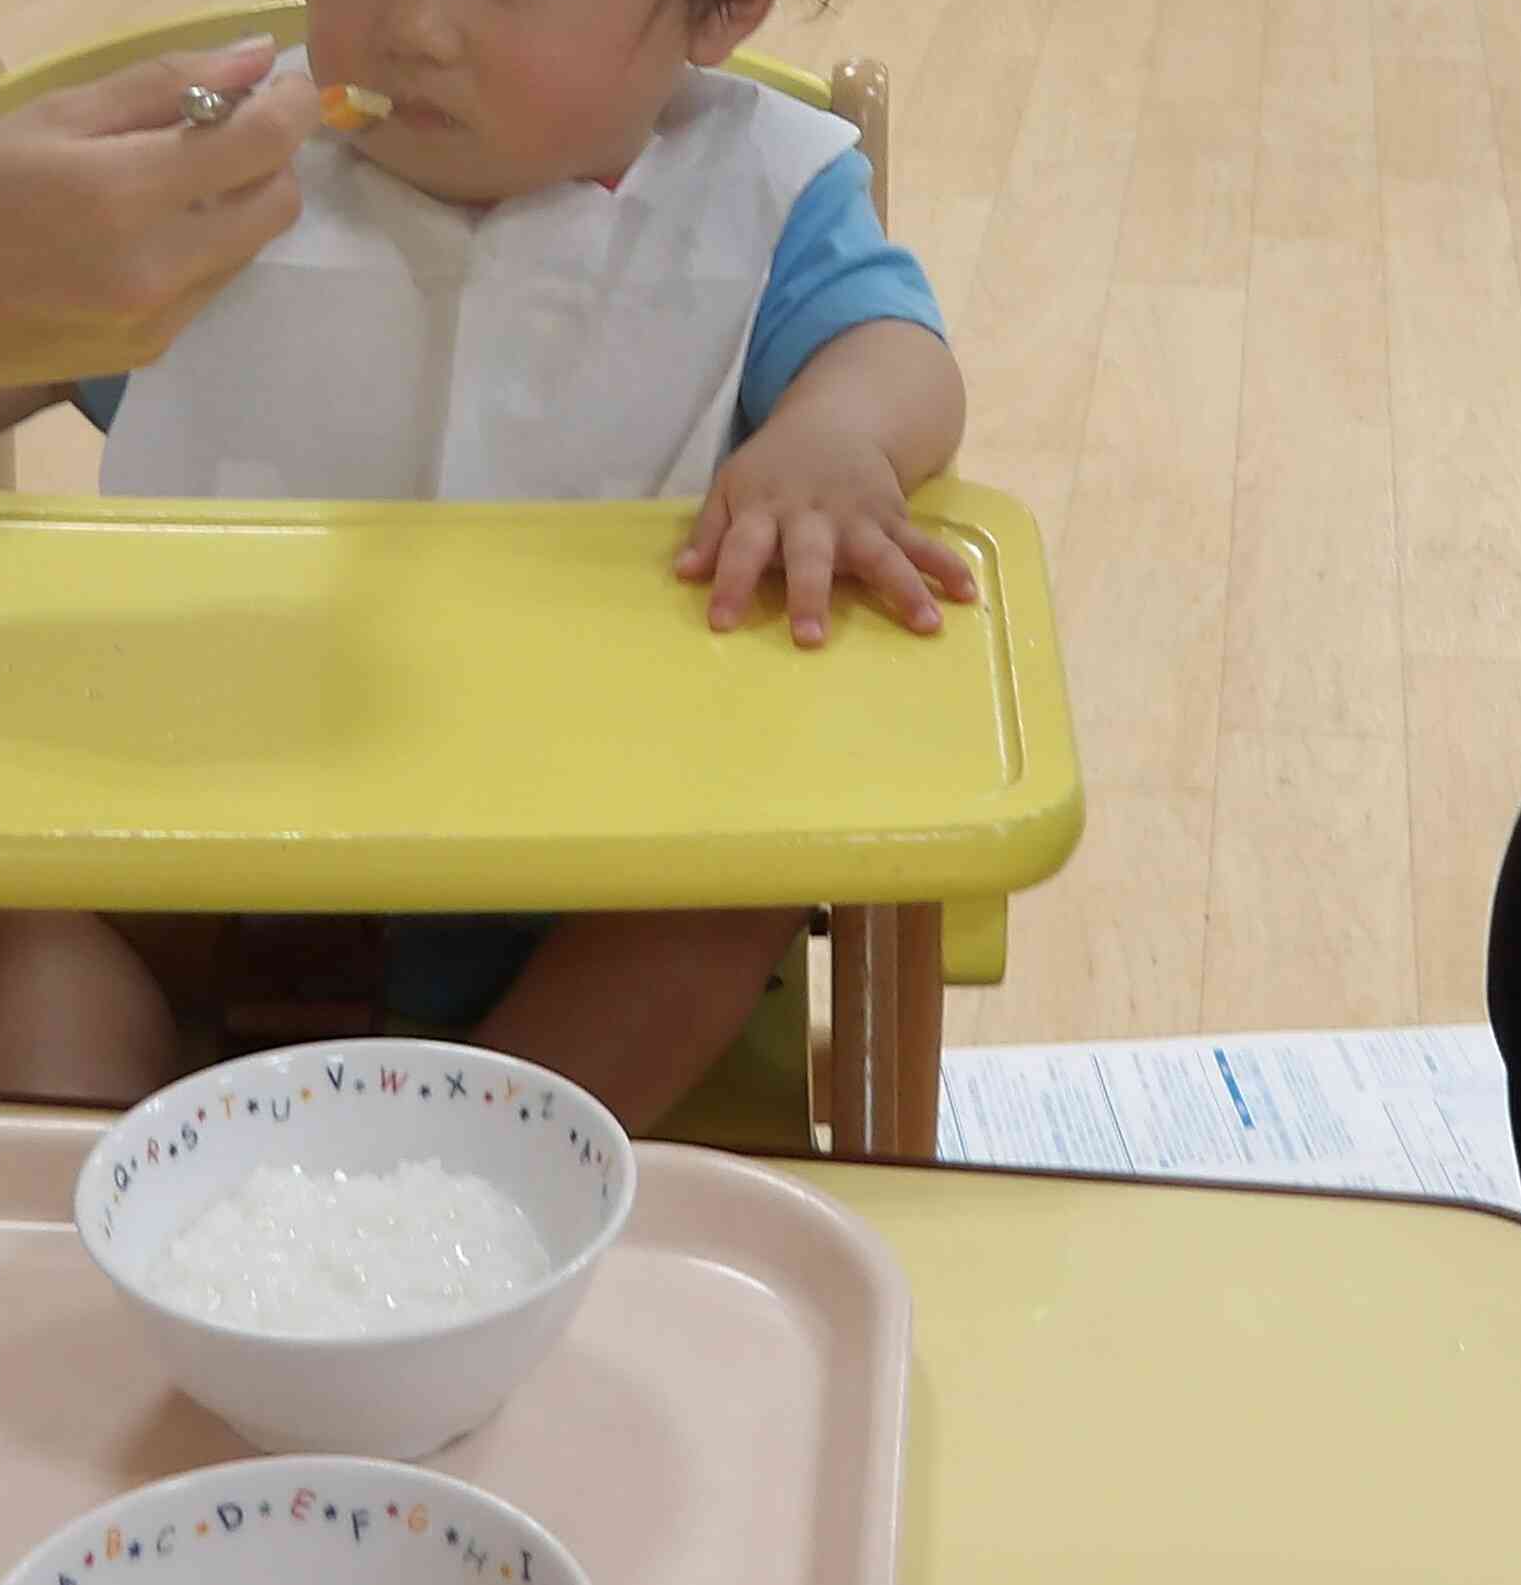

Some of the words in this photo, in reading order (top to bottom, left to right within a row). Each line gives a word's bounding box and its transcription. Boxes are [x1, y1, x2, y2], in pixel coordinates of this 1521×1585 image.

[113, 1163, 131, 1193] Q
[147, 1136, 160, 1165] R
[181, 1121, 199, 1152] S
[271, 1096, 291, 1123] U
[326, 1063, 345, 1093] V
[379, 1064, 409, 1097] W
[444, 1069, 467, 1100] X
[155, 1523, 176, 1555] C
[216, 1501, 244, 1533] D
[290, 1487, 317, 1521] E
[351, 1507, 370, 1543] F
[407, 1503, 429, 1537] G
[519, 1549, 532, 1583] I
